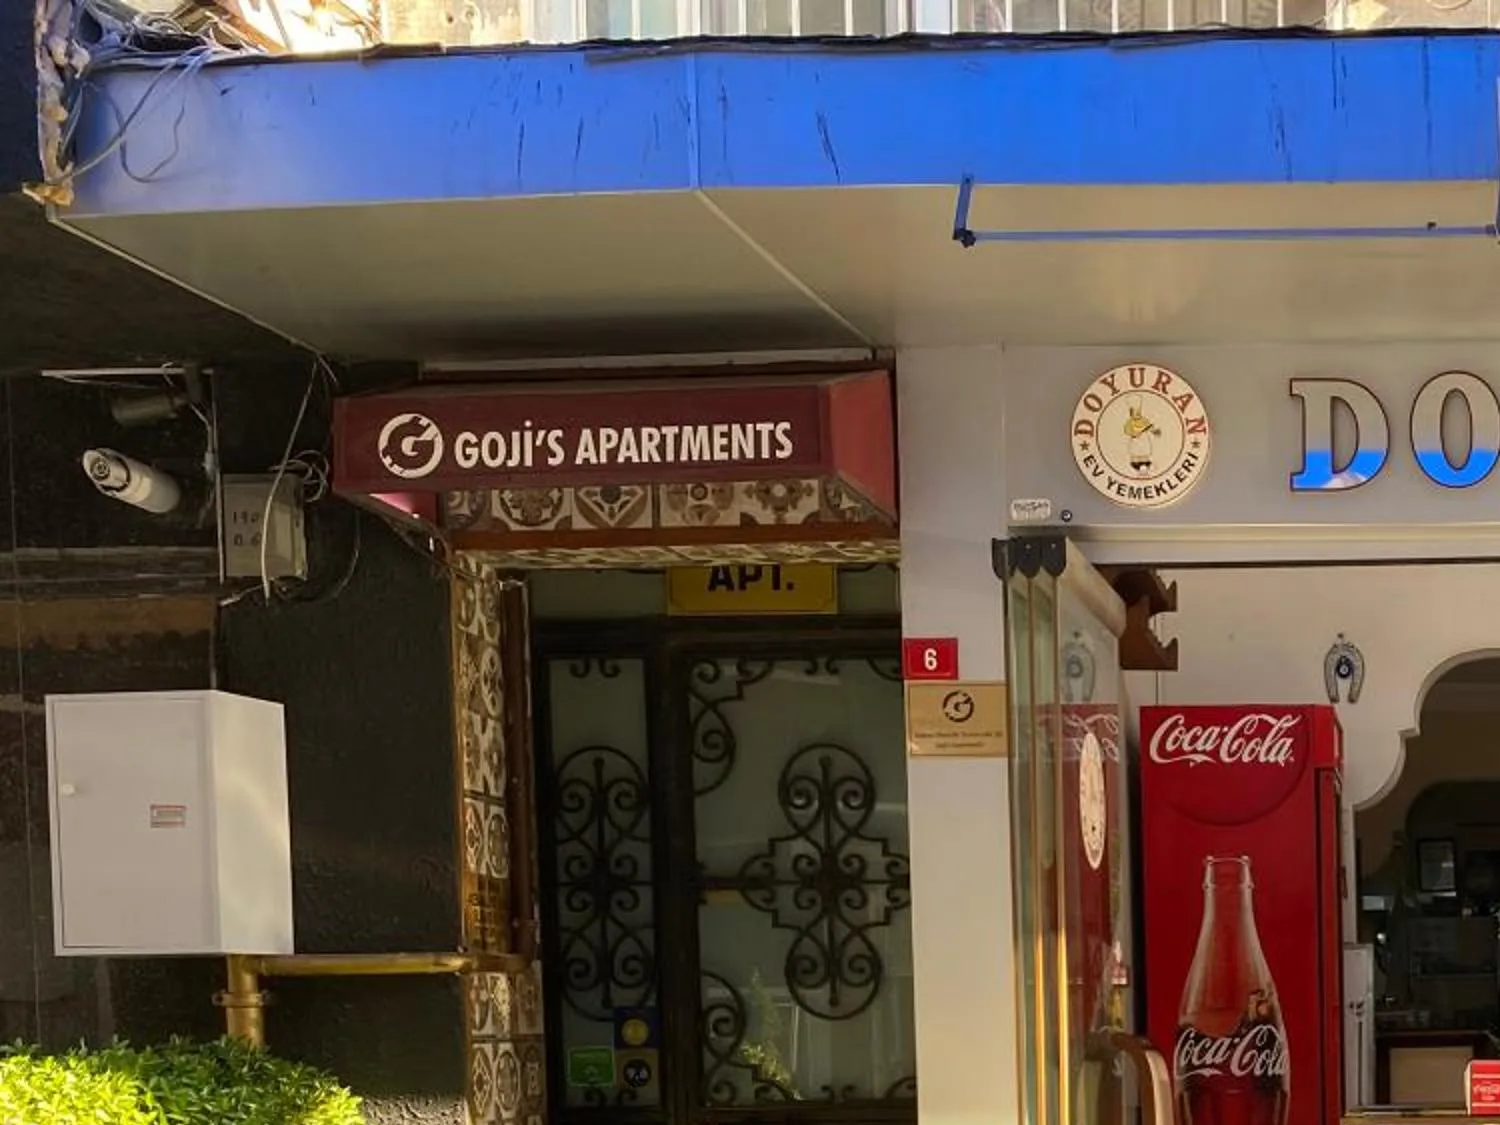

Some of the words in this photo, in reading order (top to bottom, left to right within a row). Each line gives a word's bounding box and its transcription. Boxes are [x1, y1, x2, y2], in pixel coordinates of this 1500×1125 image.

[1074, 367, 1207, 438] DOYURAN
[574, 421, 793, 466] APARTMENTS
[1083, 454, 1105, 478] EV
[923, 647, 938, 671] 6
[1149, 713, 1303, 768] Coca-Cola
